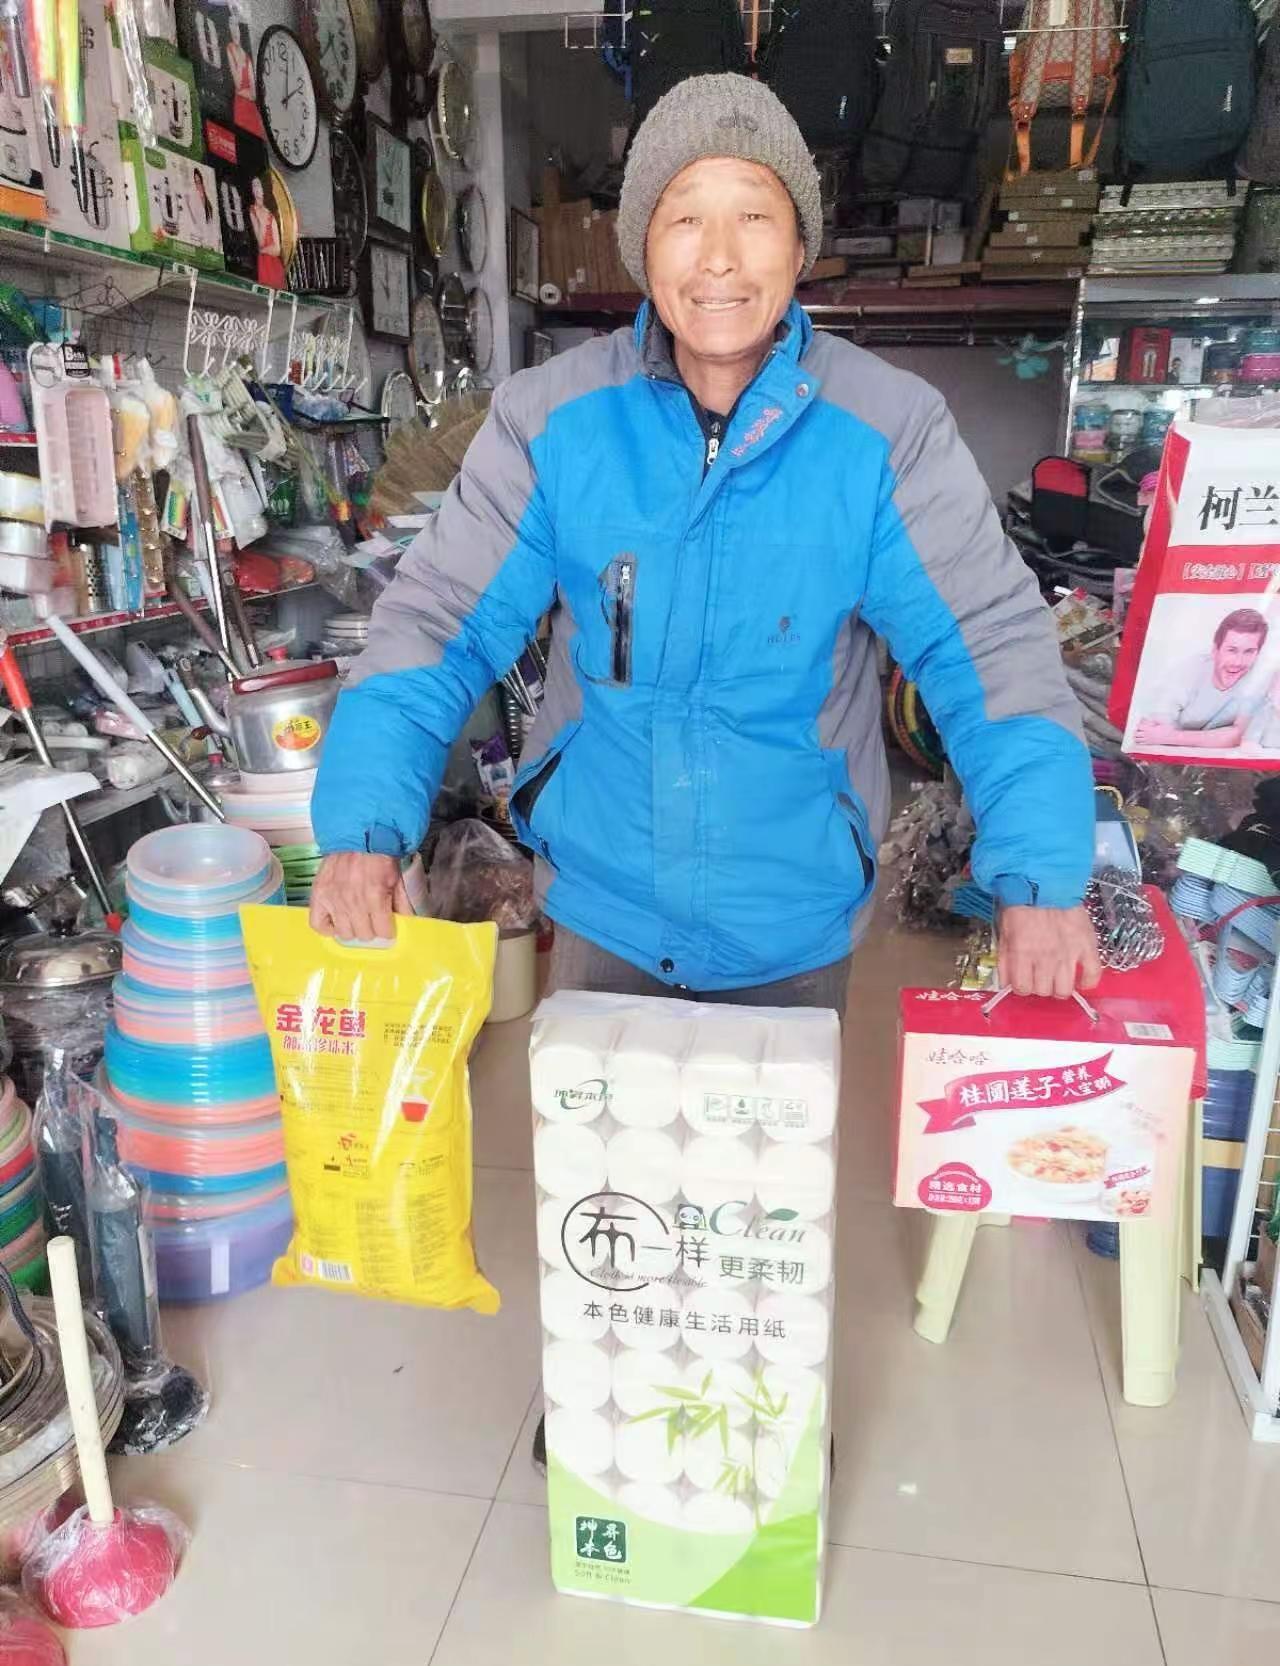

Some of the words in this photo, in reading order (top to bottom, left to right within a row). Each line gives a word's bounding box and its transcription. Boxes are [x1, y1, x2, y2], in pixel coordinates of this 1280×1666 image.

[577, 1206, 711, 1269] 布一样
[710, 1201, 806, 1243] Clean
[718, 1255, 805, 1286] 更柔韧
[583, 1300, 787, 1339] 本色健康生活用纸
